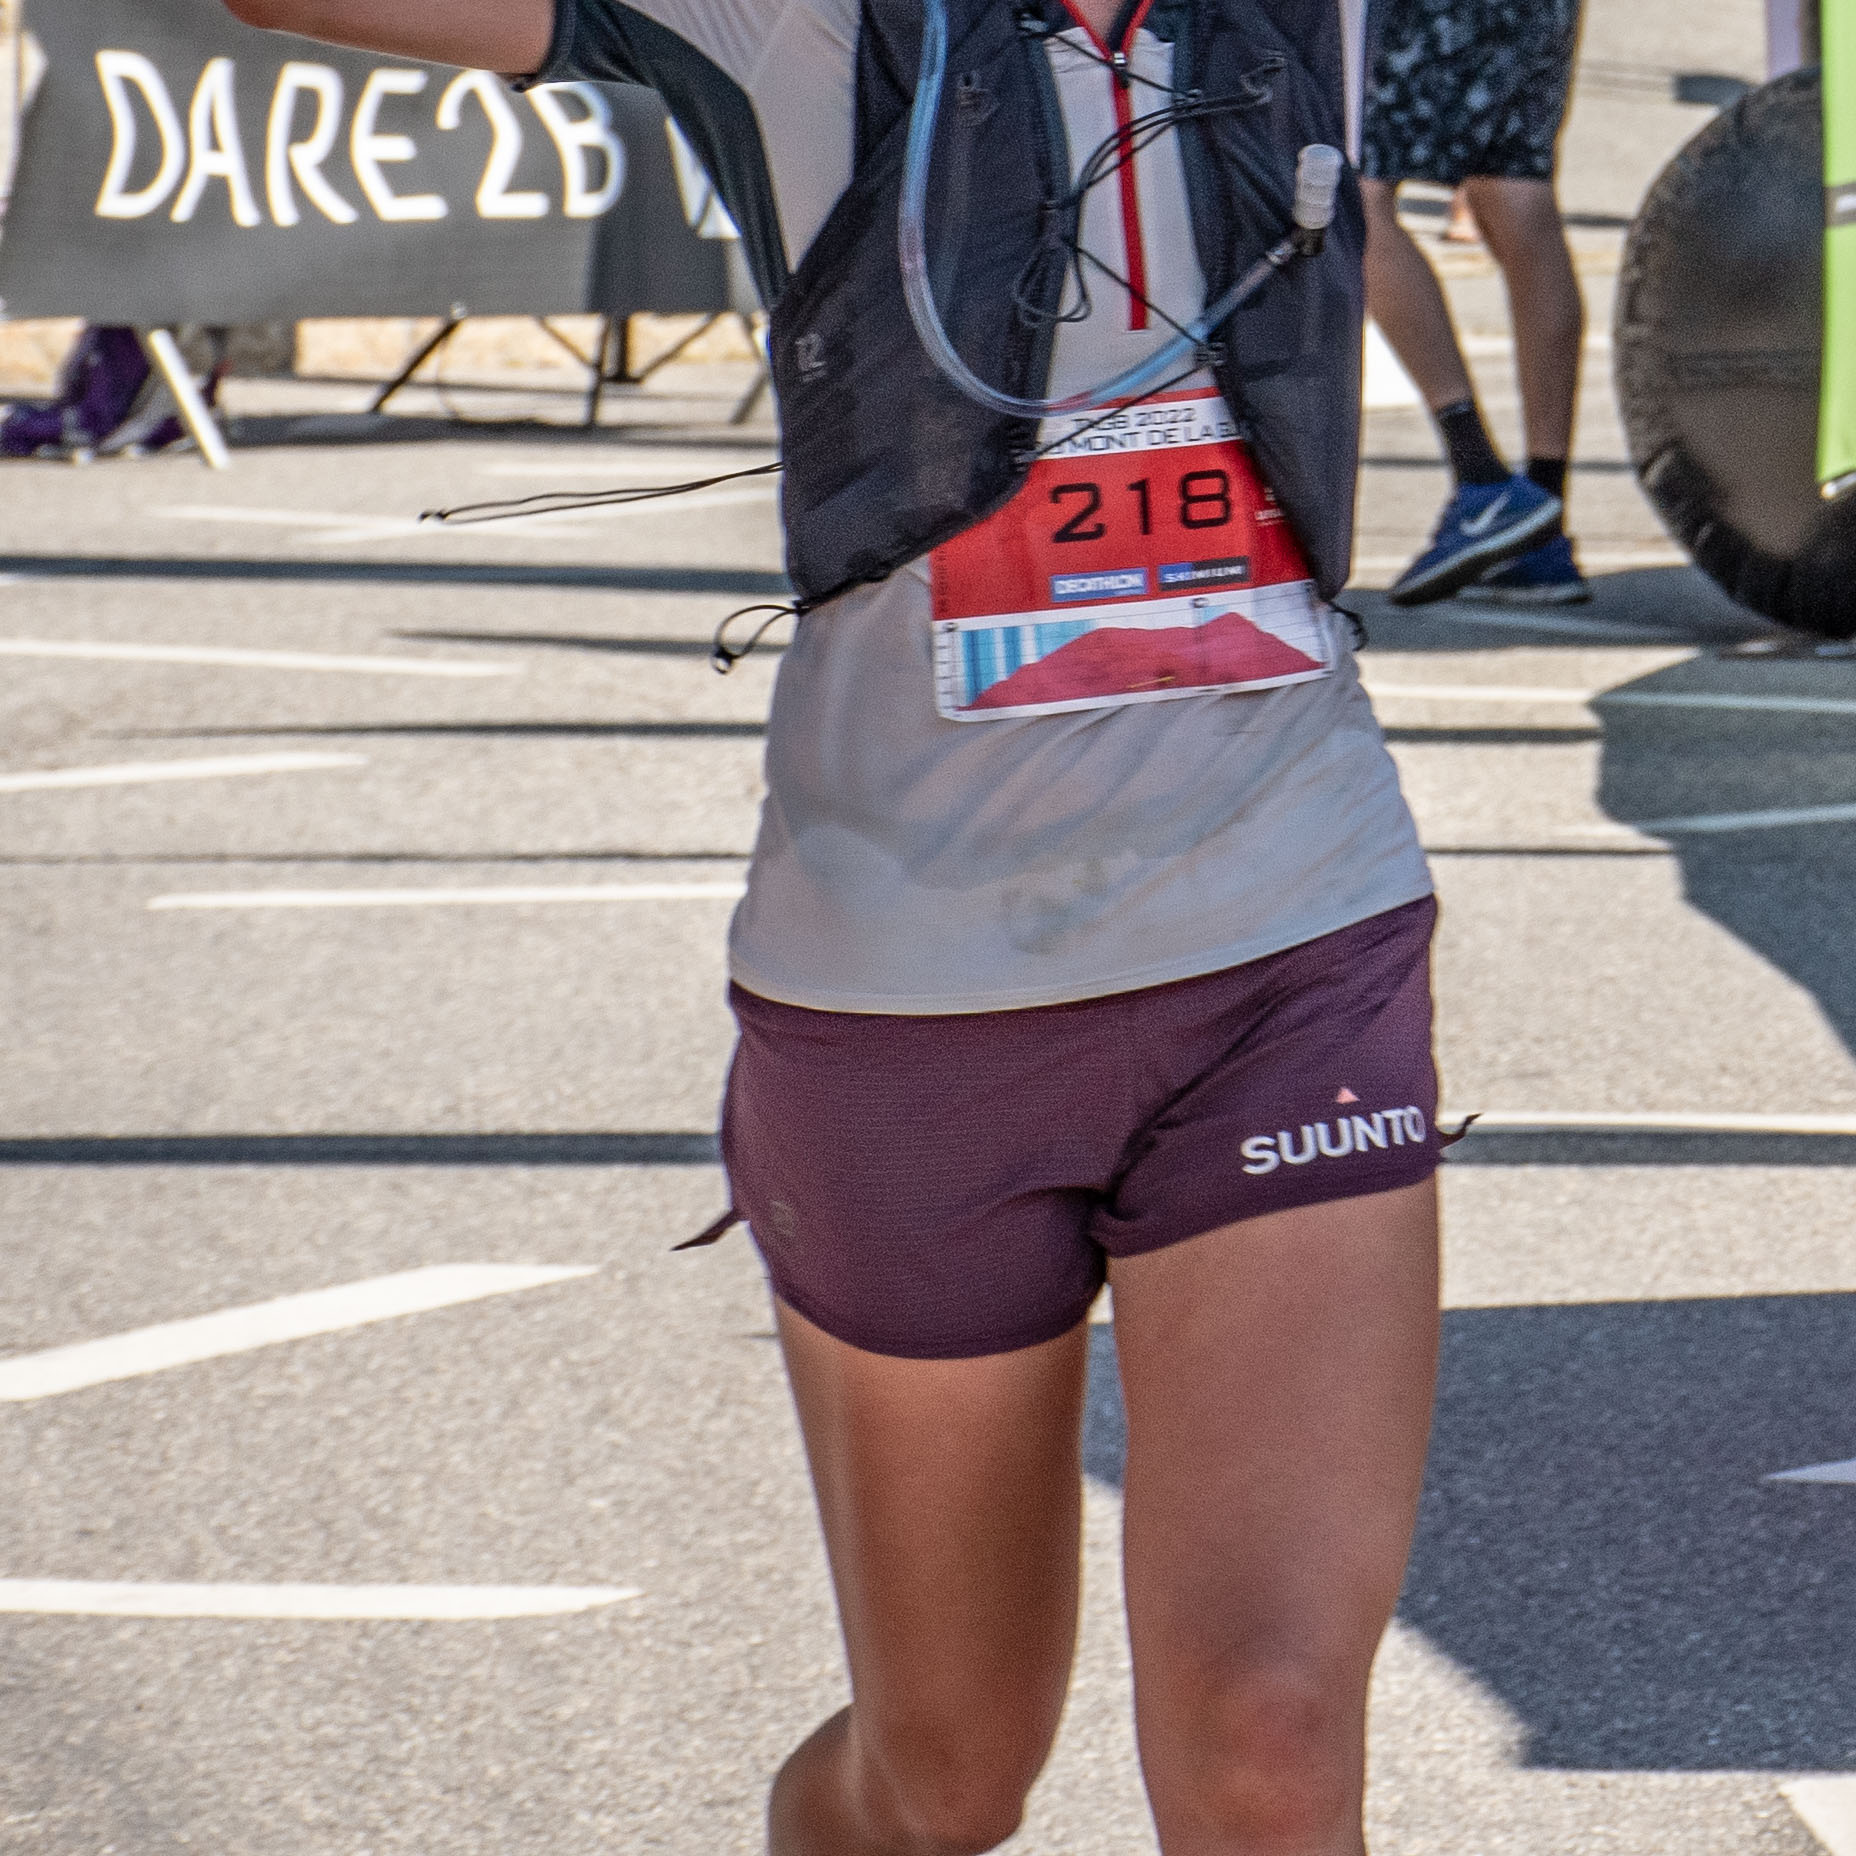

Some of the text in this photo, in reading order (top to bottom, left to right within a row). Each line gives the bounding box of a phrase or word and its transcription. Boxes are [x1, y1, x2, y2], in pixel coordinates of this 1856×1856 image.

[94, 48, 624, 227] DARE2B
[1135, 407, 1197, 427] 2022
[1050, 469, 1232, 544] 218
[1240, 1104, 1427, 1175] SUUNTO
